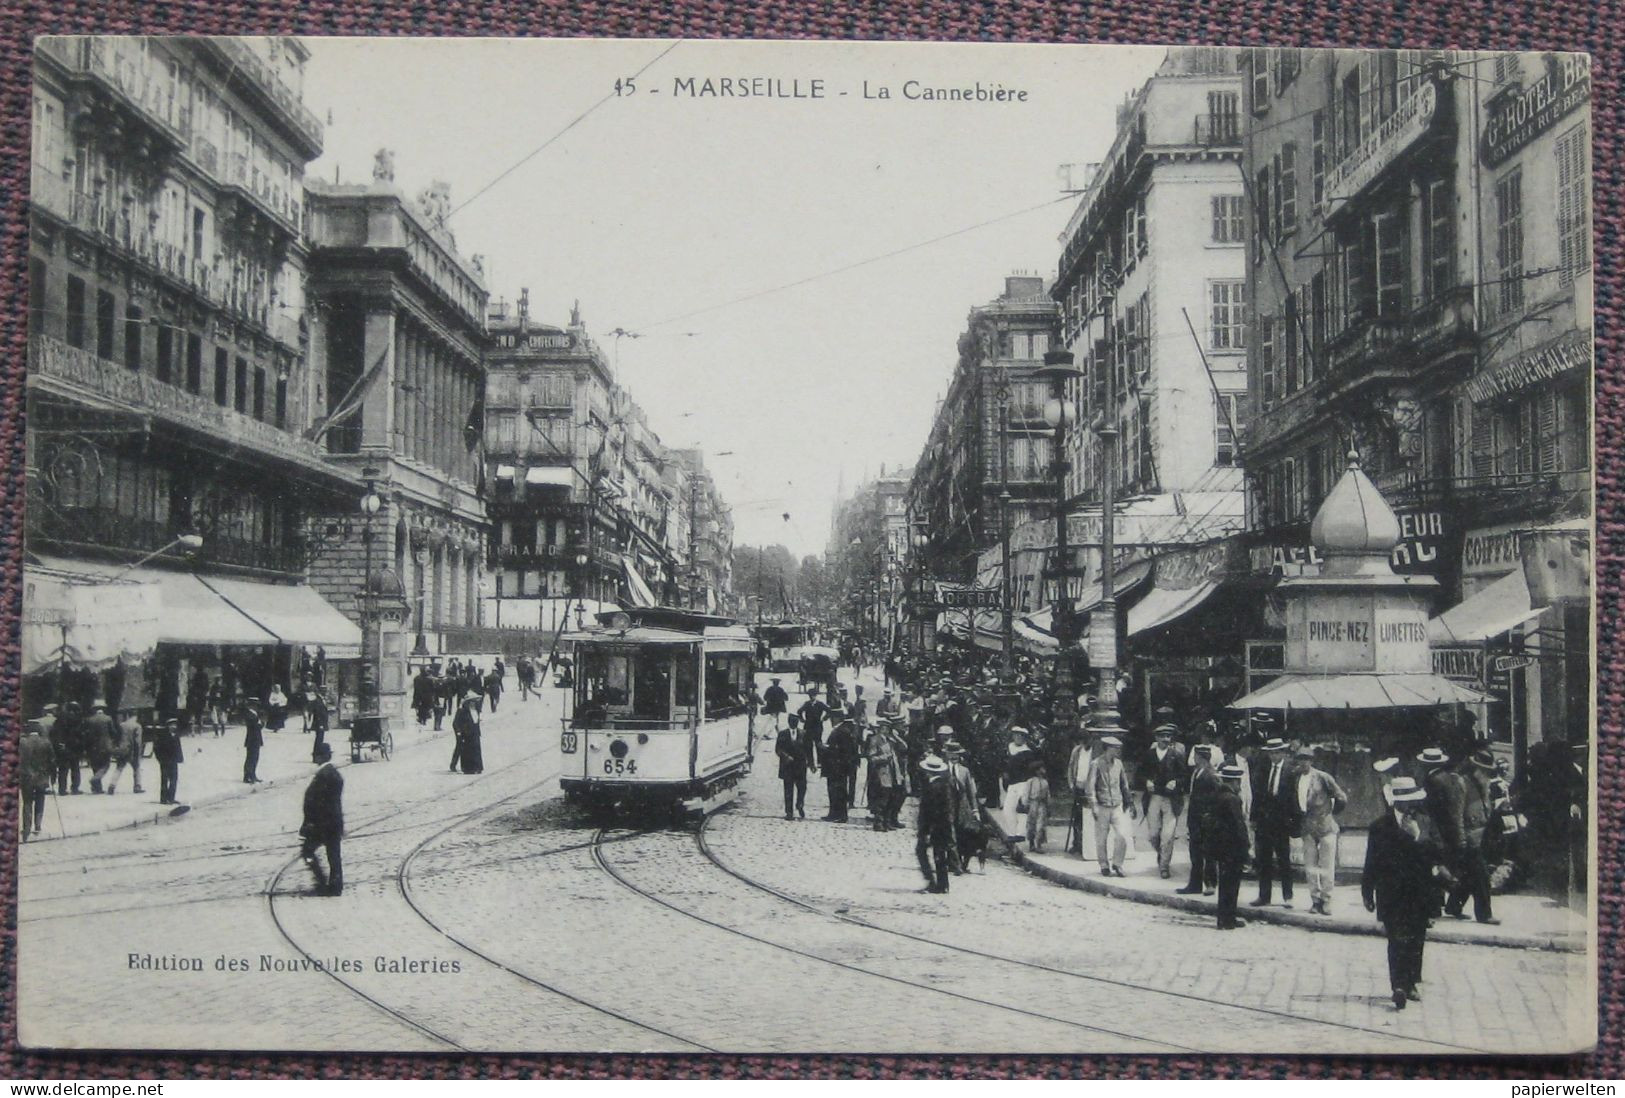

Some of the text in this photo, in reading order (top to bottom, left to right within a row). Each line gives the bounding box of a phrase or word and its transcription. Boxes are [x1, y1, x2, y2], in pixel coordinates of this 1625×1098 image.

[1309, 620, 1426, 643] PINCE-NEZ LUNETTES
[562, 734, 576, 751] 32
[603, 759, 637, 774] 654
